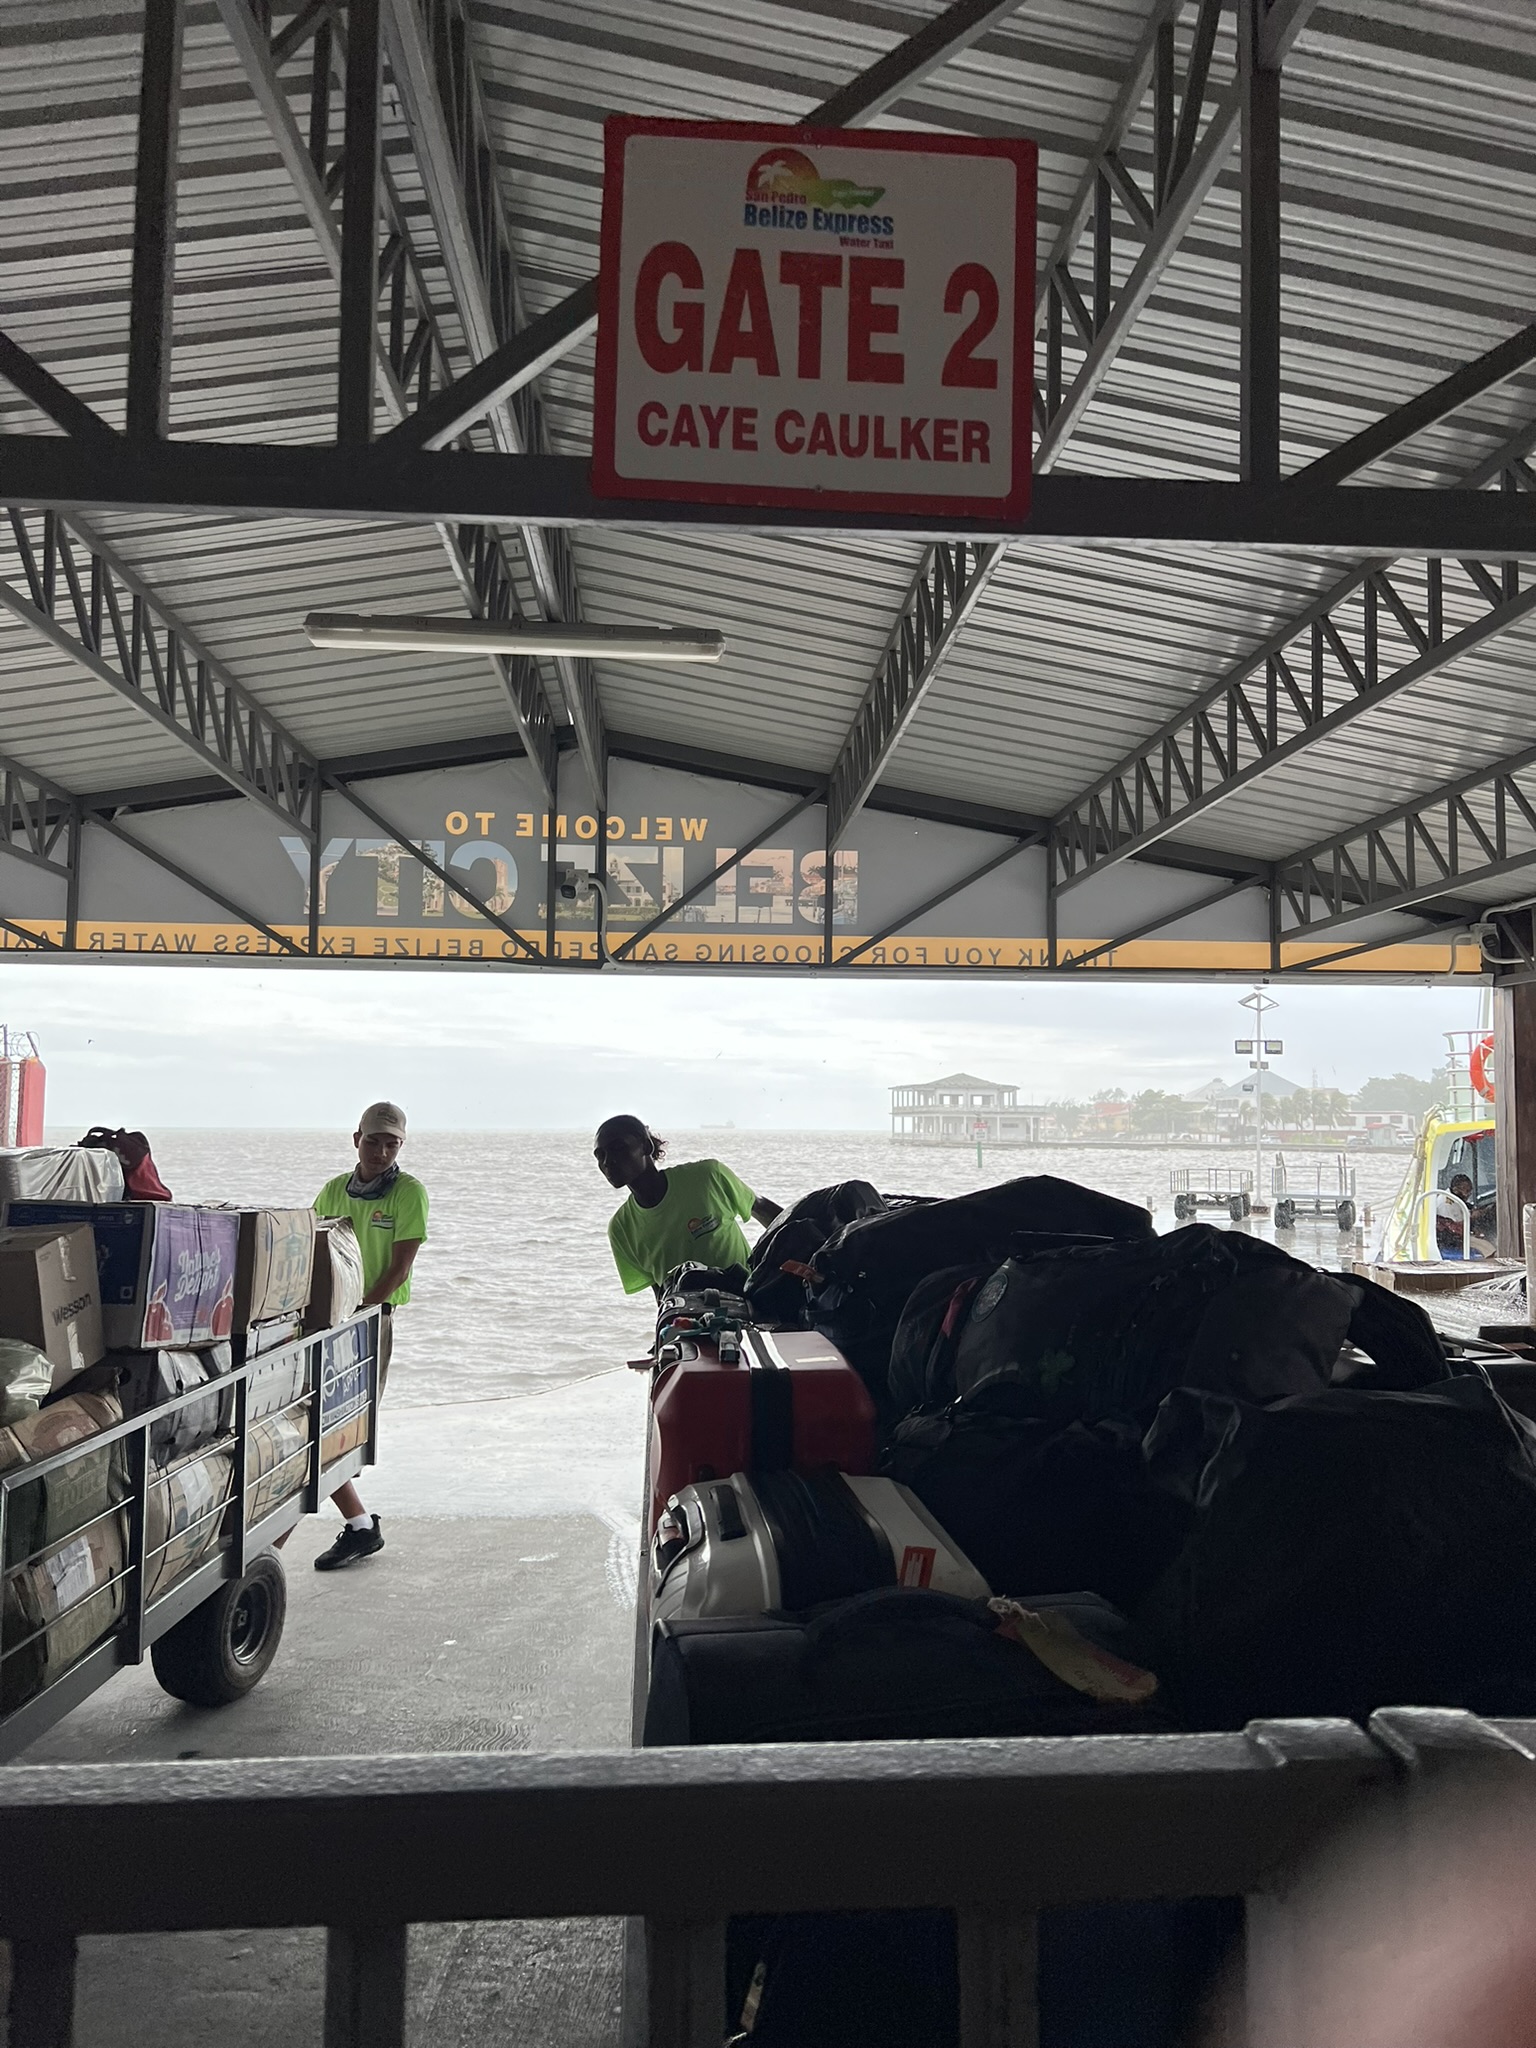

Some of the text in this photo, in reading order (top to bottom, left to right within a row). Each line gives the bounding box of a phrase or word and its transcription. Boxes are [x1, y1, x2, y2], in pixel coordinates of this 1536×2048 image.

[745, 190, 807, 205] San Pedro
[744, 203, 894, 236] Belize Express
[839, 236, 894, 250] Water Taxi
[634, 241, 999, 389] GATE 2
[637, 401, 991, 464] CAYE CAULKER
